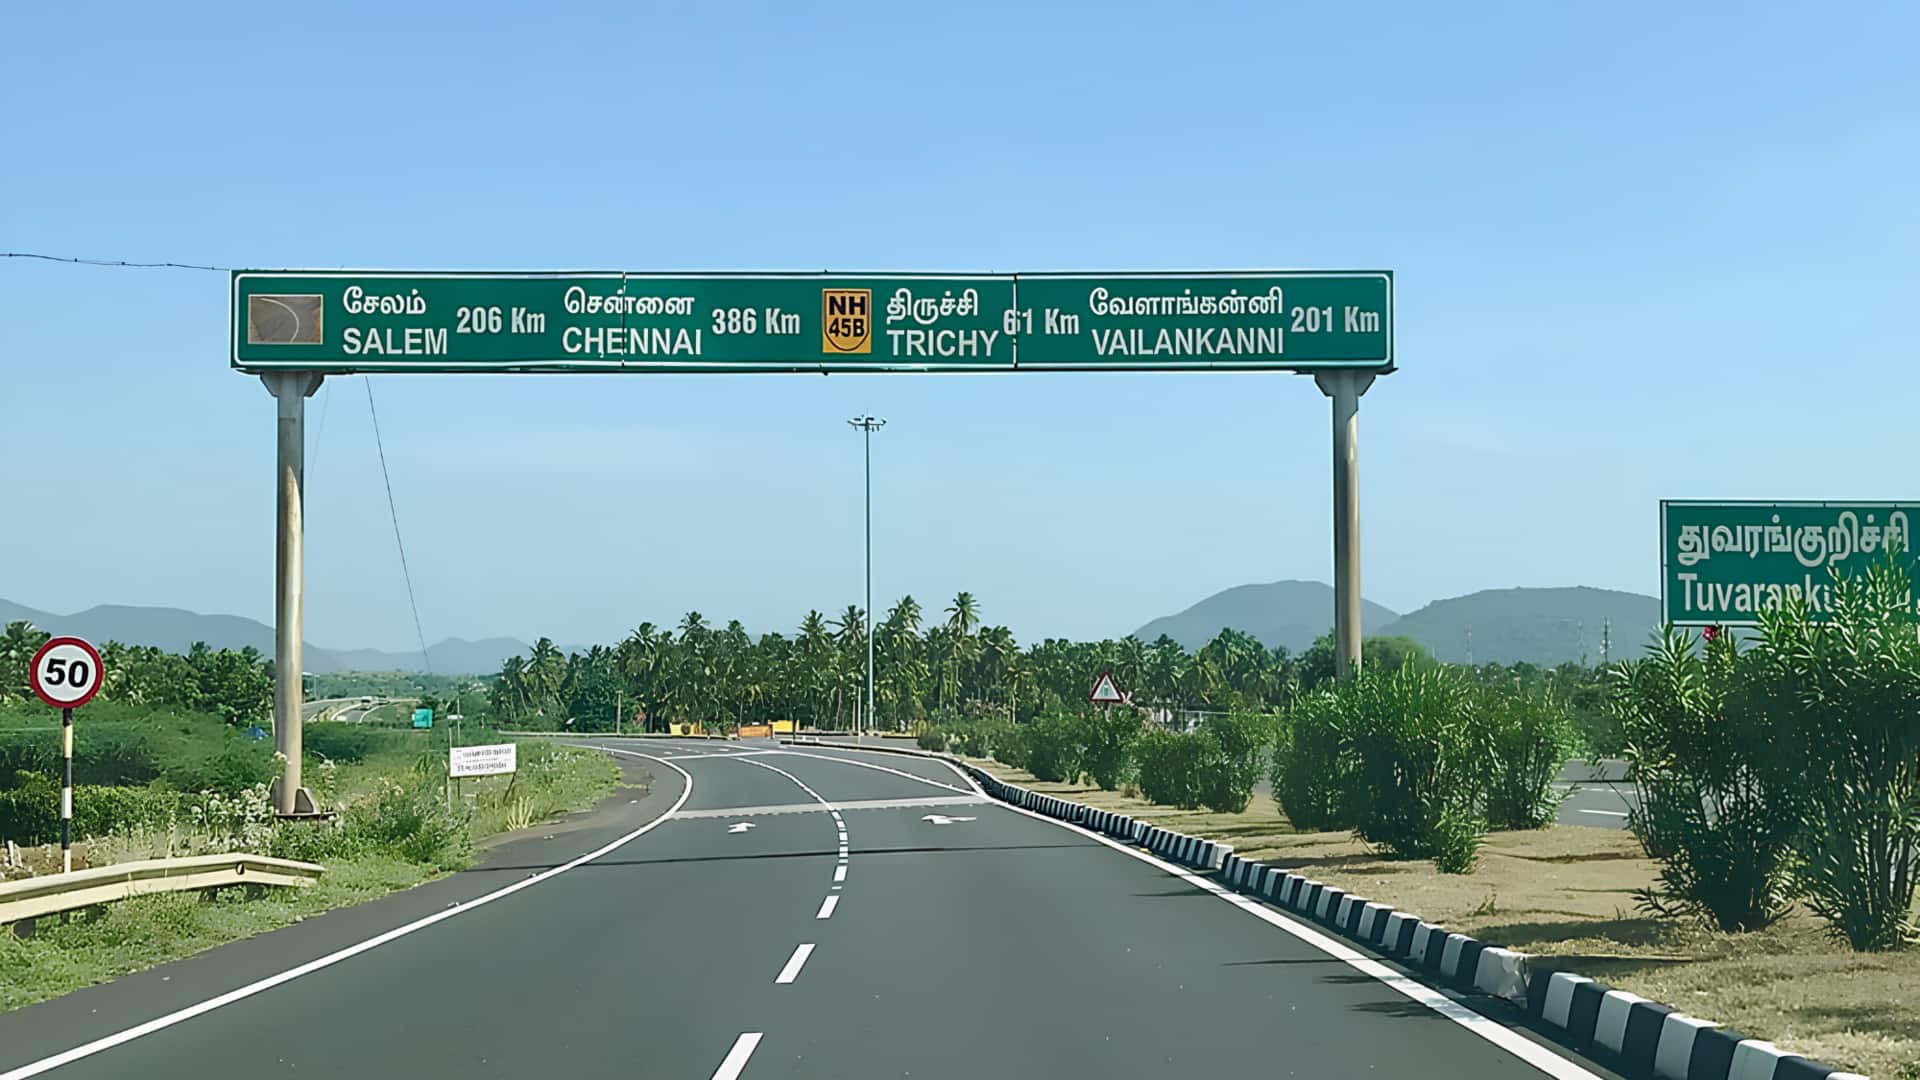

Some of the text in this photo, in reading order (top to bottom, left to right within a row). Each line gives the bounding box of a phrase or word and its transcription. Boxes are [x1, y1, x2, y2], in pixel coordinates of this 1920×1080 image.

[343, 286, 426, 315] சேலம்
[564, 286, 695, 316] சென்னை
[828, 295, 866, 316] NH
[886, 287, 979, 326] திருச்சி
[1089, 286, 1284, 316] வேளாங்கன்னி
[456, 307, 546, 334] 206 Km
[711, 308, 801, 335] 386 Km
[828, 318, 866, 338] 45B
[1003, 307, 1080, 336] 61 Km
[1291, 306, 1380, 333] 201 Km
[342, 327, 448, 355] SALEM
[562, 326, 702, 357] CHENNAI
[886, 329, 1000, 357] TRICHY
[1091, 327, 1285, 356] VAILANKANNI
[1678, 511, 1910, 568] துவரங்குறிச்சி
[44, 658, 90, 688] 50
